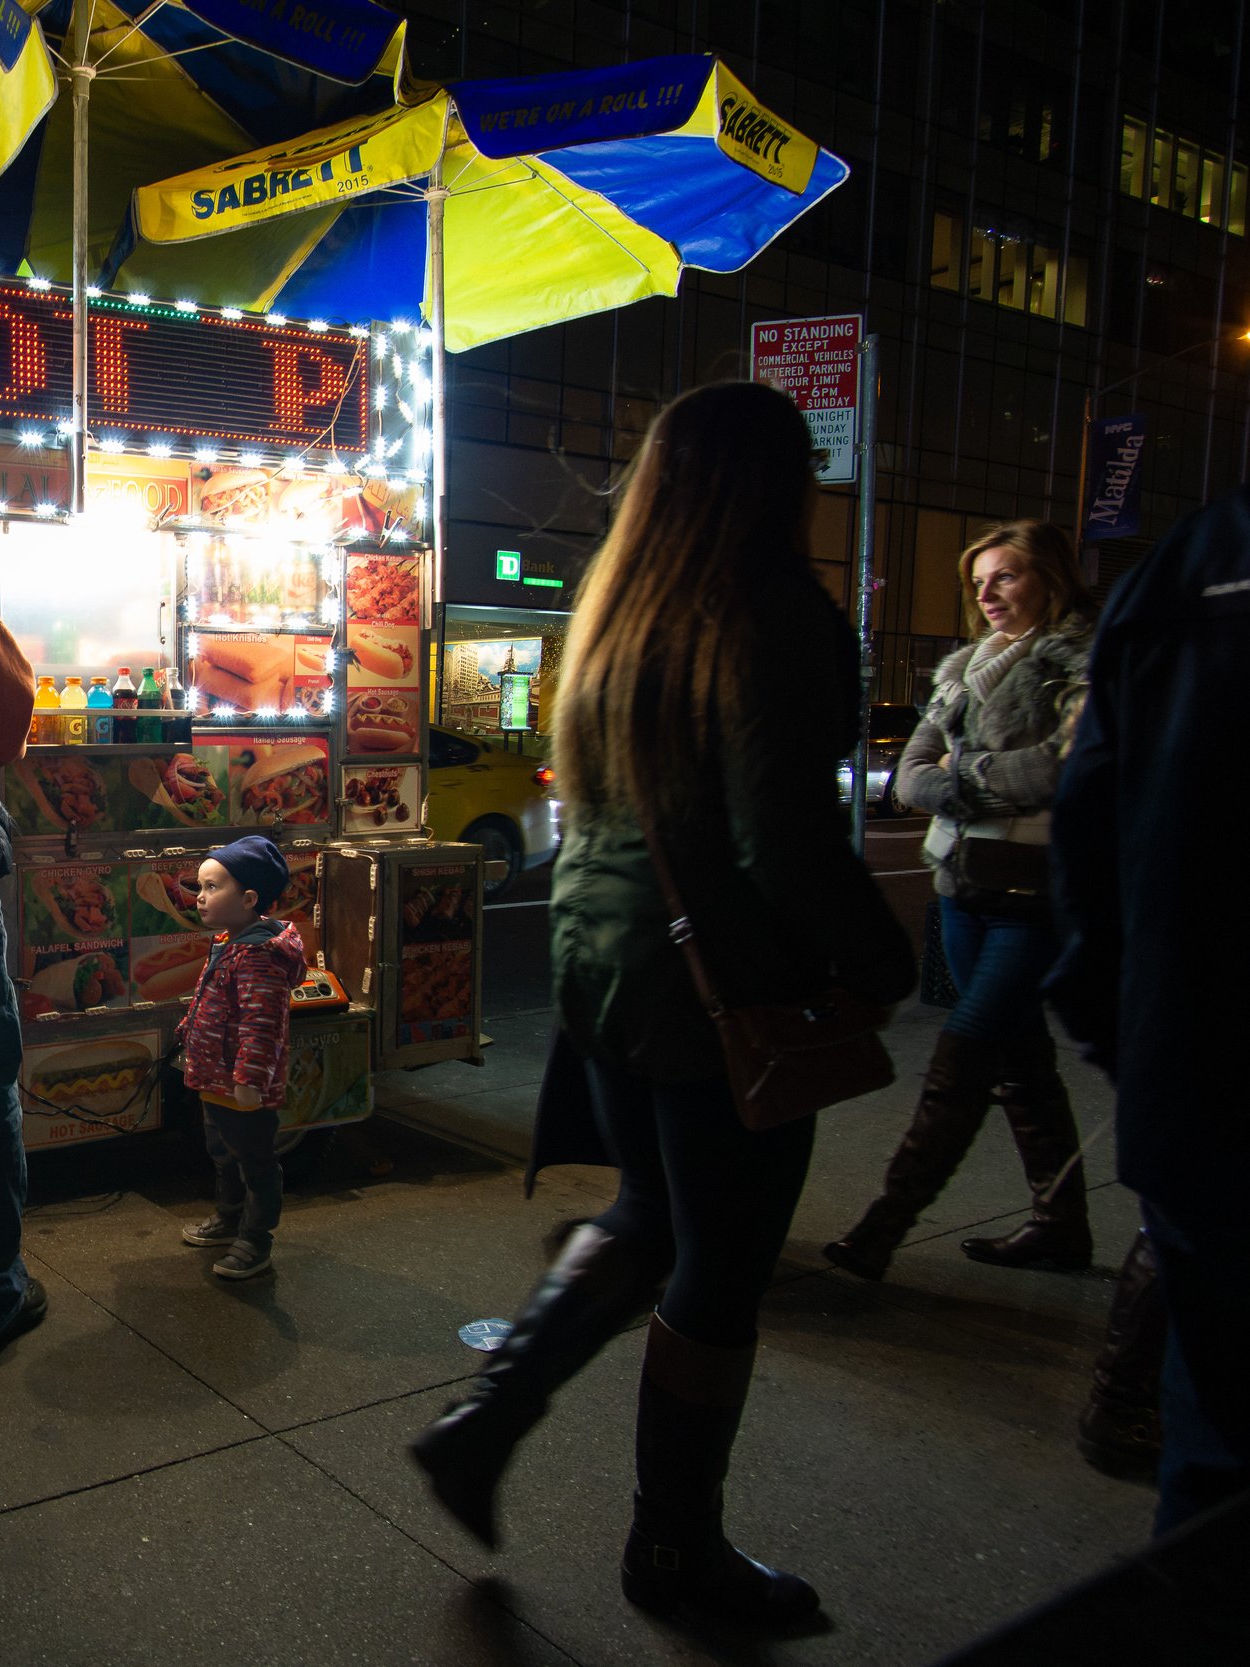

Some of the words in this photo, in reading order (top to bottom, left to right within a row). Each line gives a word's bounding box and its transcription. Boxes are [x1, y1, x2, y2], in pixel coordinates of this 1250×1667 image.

[270, 1, 286, 21] A
[288, 5, 336, 42] ROLL
[479, 105, 543, 134] WE'RE
[545, 101, 577, 123] ON
[579, 98, 595, 118] A
[598, 89, 649, 116] ROLL
[337, 174, 370, 193] 2015
[759, 329, 778, 343] NO
[784, 323, 854, 341] STANDING
[782, 340, 829, 353] EXCEPT
[758, 353, 810, 366] COMMERCIAL
[814, 350, 854, 362] VEHICLES
[759, 366, 805, 379] METERED
[809, 363, 851, 375] PARKING
[262, 340, 346, 434] P
[780, 377, 810, 387] HOUR
[813, 374, 841, 386] LIMIT
[811, 386, 838, 398] 6PM
[806, 396, 850, 409] SUNDAY
[812, 436, 850, 447] ARKING
[1088, 433, 1145, 526] Matilda
[499, 556, 519, 575] TD
[522, 559, 556, 574] Bank
[215, 633, 231, 642] Hot
[367, 688, 377, 696] Hot
[377, 688, 400, 697] Sausage
[366, 769, 399, 779] Chestnuts
[40, 867, 85, 879] CHICKEN
[151, 861, 173, 871] BEEF
[75, 938, 124, 952] SANDWICH
[160, 934, 181, 944] HOT
[309, 1033, 340, 1050] Gyro
[50, 1124, 76, 1139] HOT
